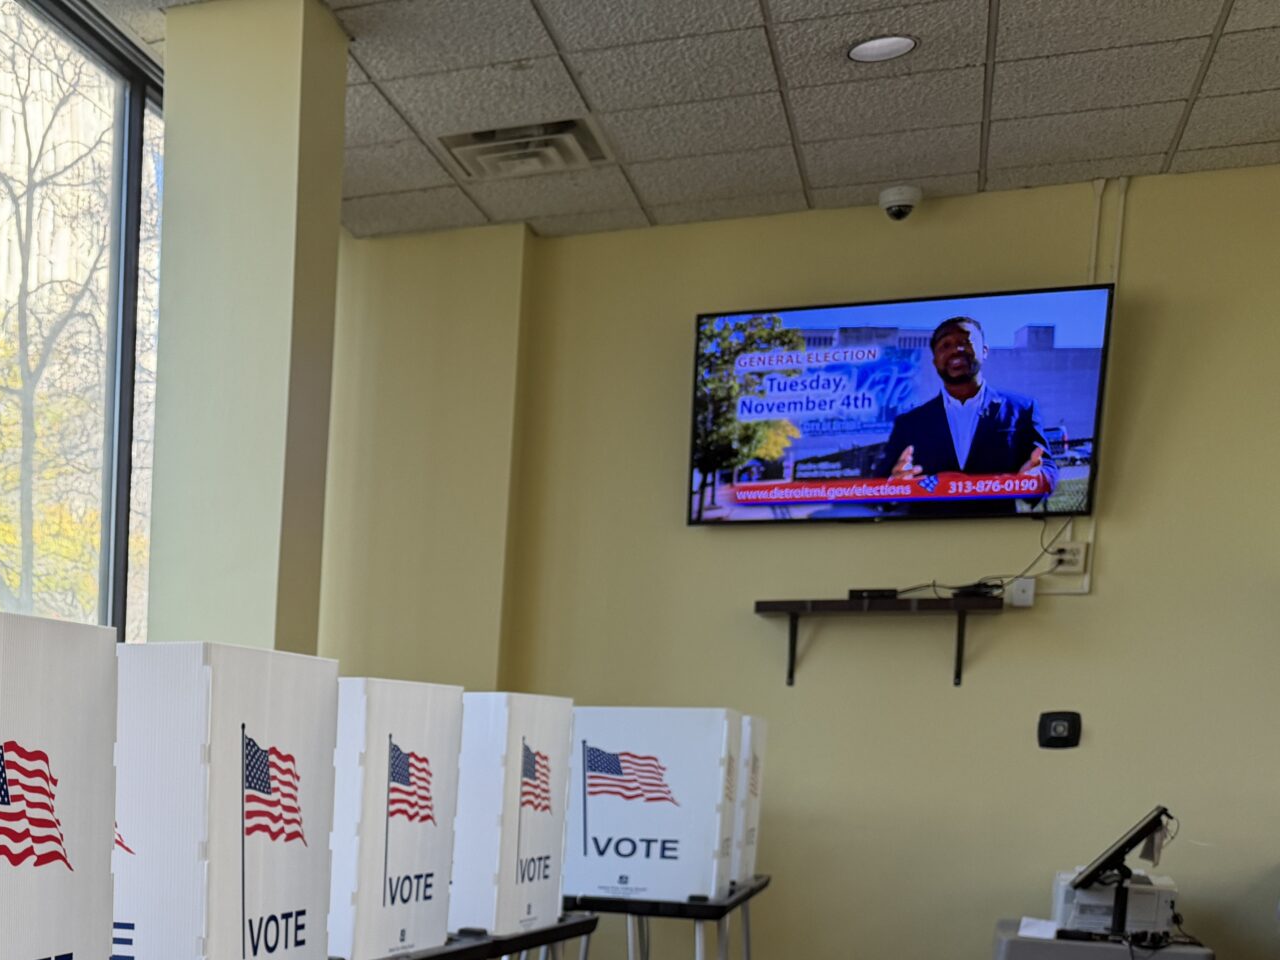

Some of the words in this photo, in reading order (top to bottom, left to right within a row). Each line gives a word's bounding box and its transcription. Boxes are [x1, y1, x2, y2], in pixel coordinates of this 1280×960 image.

[738, 353, 802, 368] GENERAL
[806, 349, 877, 364] ELECTION
[767, 373, 847, 393] Tuesday,
[740, 396, 836, 415] November
[840, 392, 873, 409] 4th
[736, 483, 912, 500] www.detroitmi.gov/elections
[948, 479, 1038, 494] 313-876-0190
[592, 836, 680, 860] VOTE
[519, 855, 551, 884] VOTE
[388, 872, 435, 906] VOTE
[248, 909, 307, 957] VOTE
